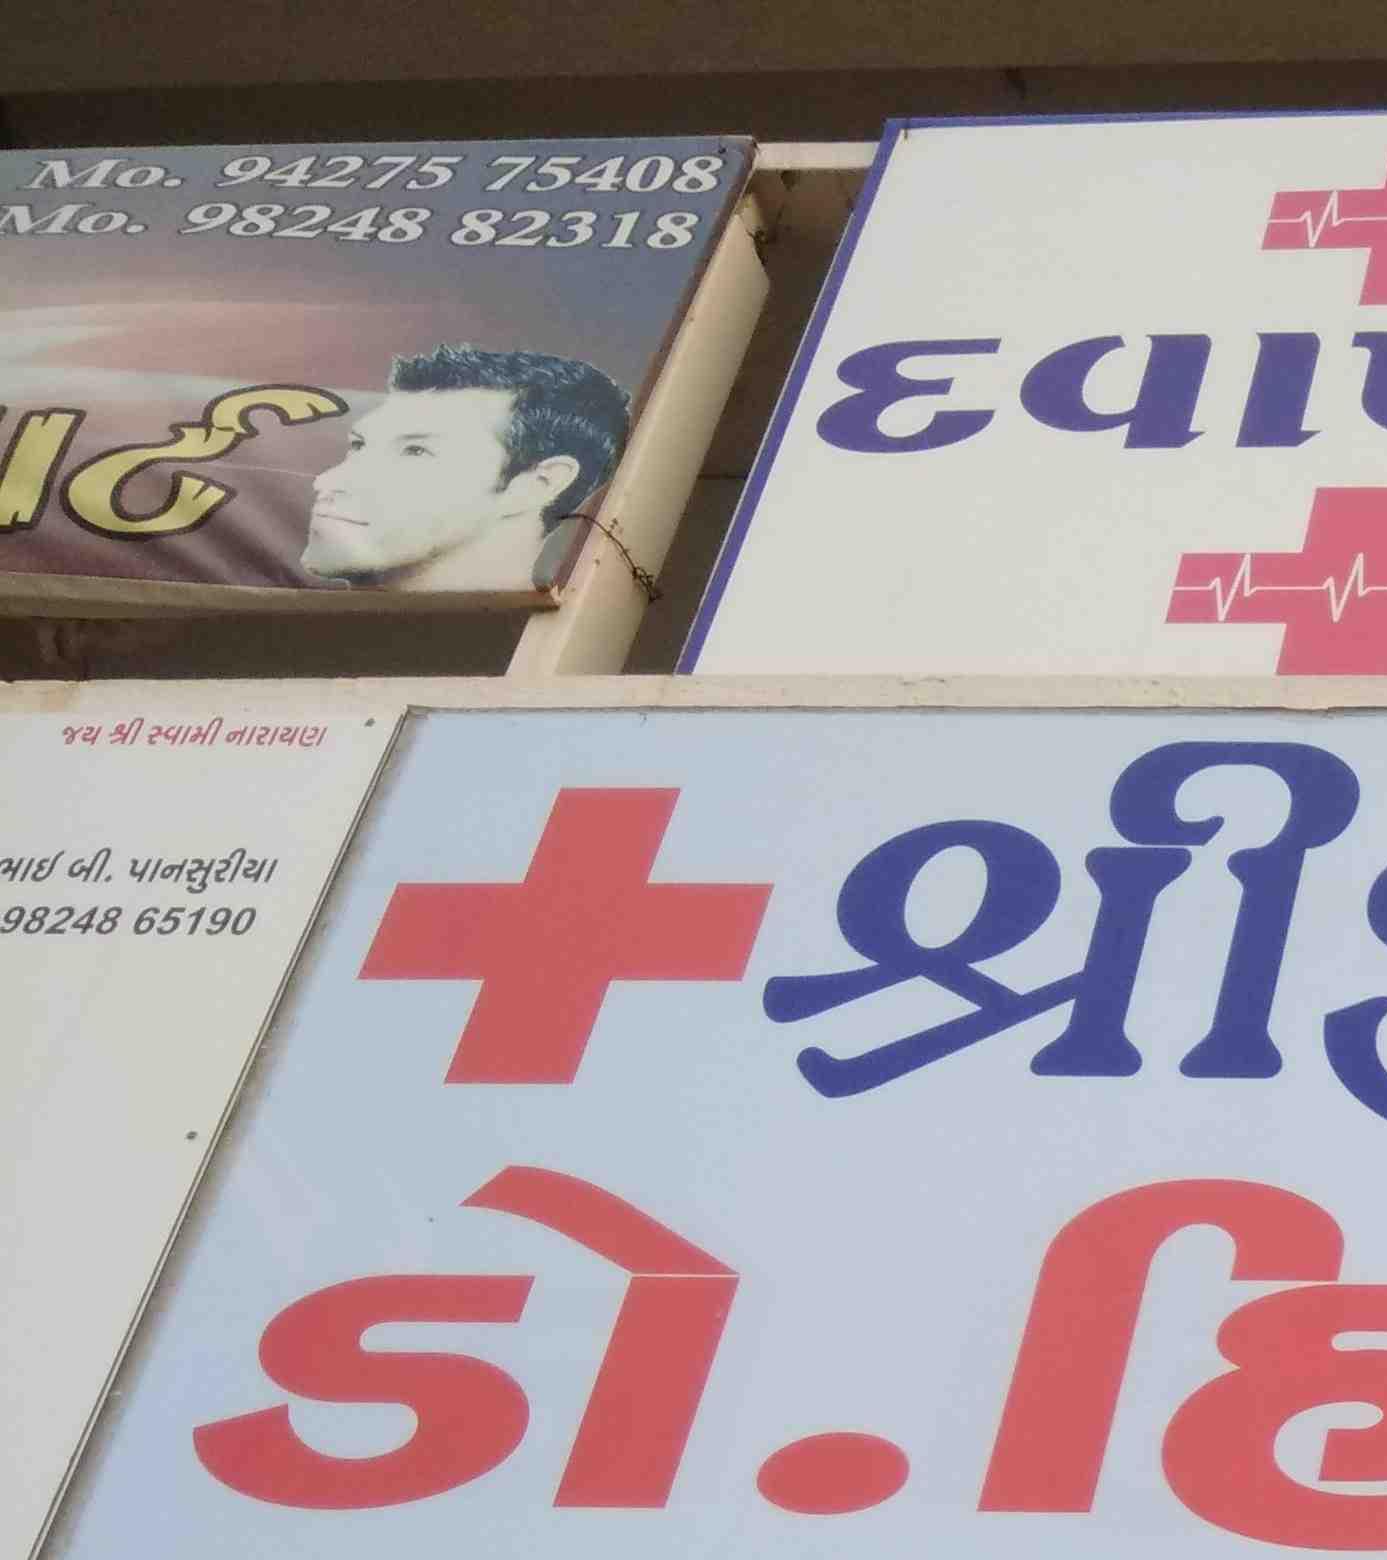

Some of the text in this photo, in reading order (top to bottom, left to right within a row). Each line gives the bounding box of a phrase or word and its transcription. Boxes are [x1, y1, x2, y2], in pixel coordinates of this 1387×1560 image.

[23, 155, 724, 194] Mo. 94275 75408
[0, 201, 700, 250] Mo. 98248 82318
[62, 716, 328, 747] જય શ્રી સ્વામી નારાયણ
[67, 847, 113, 883] બી.
[129, 847, 278, 895] પાનસુરીયા
[0, 905, 257, 936] 98248 65190
